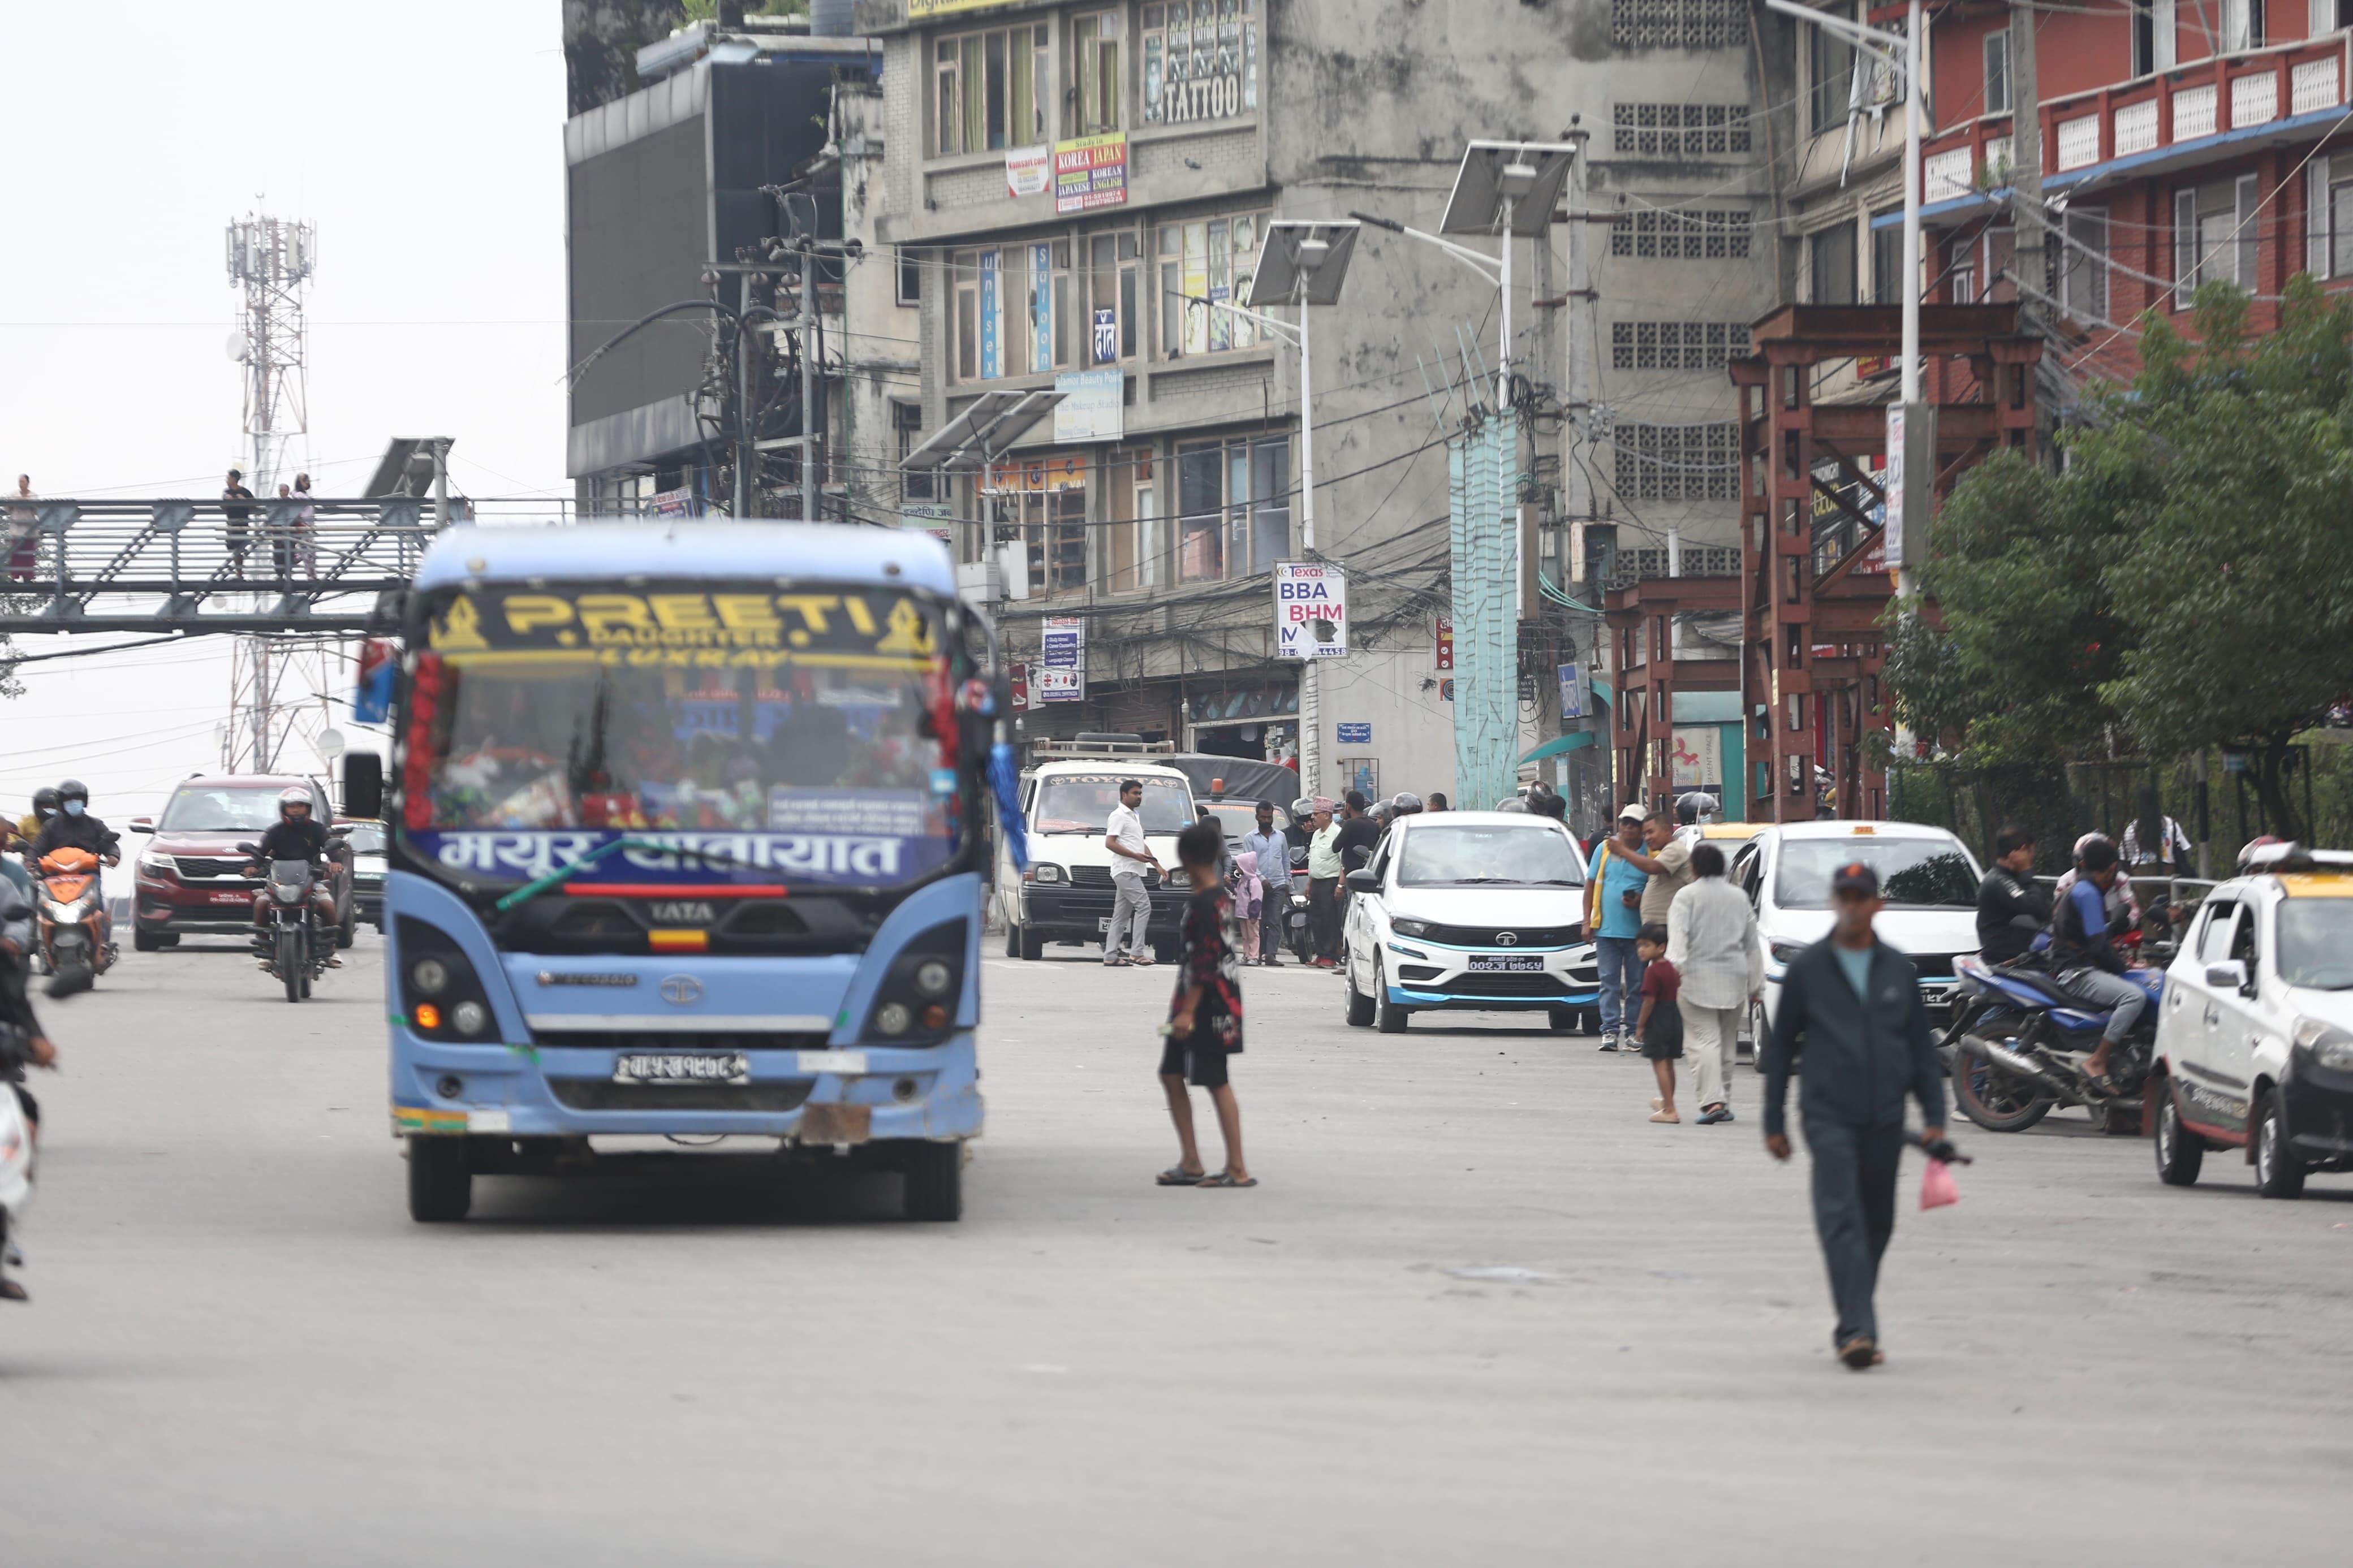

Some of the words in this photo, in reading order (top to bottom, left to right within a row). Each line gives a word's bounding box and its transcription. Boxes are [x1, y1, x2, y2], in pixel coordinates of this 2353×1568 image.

[1165, 74, 1238, 123] TATTOO
[1058, 150, 1090, 169] KOREA
[1093, 144, 1121, 166] JAPAN
[1092, 165, 1122, 179] KOREAN
[1058, 182, 1091, 196] JAPANESE
[1093, 176, 1122, 191] ENGLISH
[1080, 374, 1103, 386] Beauty
[1104, 372, 1122, 383] Point
[1288, 565, 1324, 577] Texas
[1281, 582, 1329, 599] BBA
[1289, 603, 1342, 621] BHM
[1066, 776, 1163, 787] TOYOTA
[438, 831, 602, 879] मयूर
[622, 831, 903, 876] यातायात
[650, 902, 715, 920] TATA
